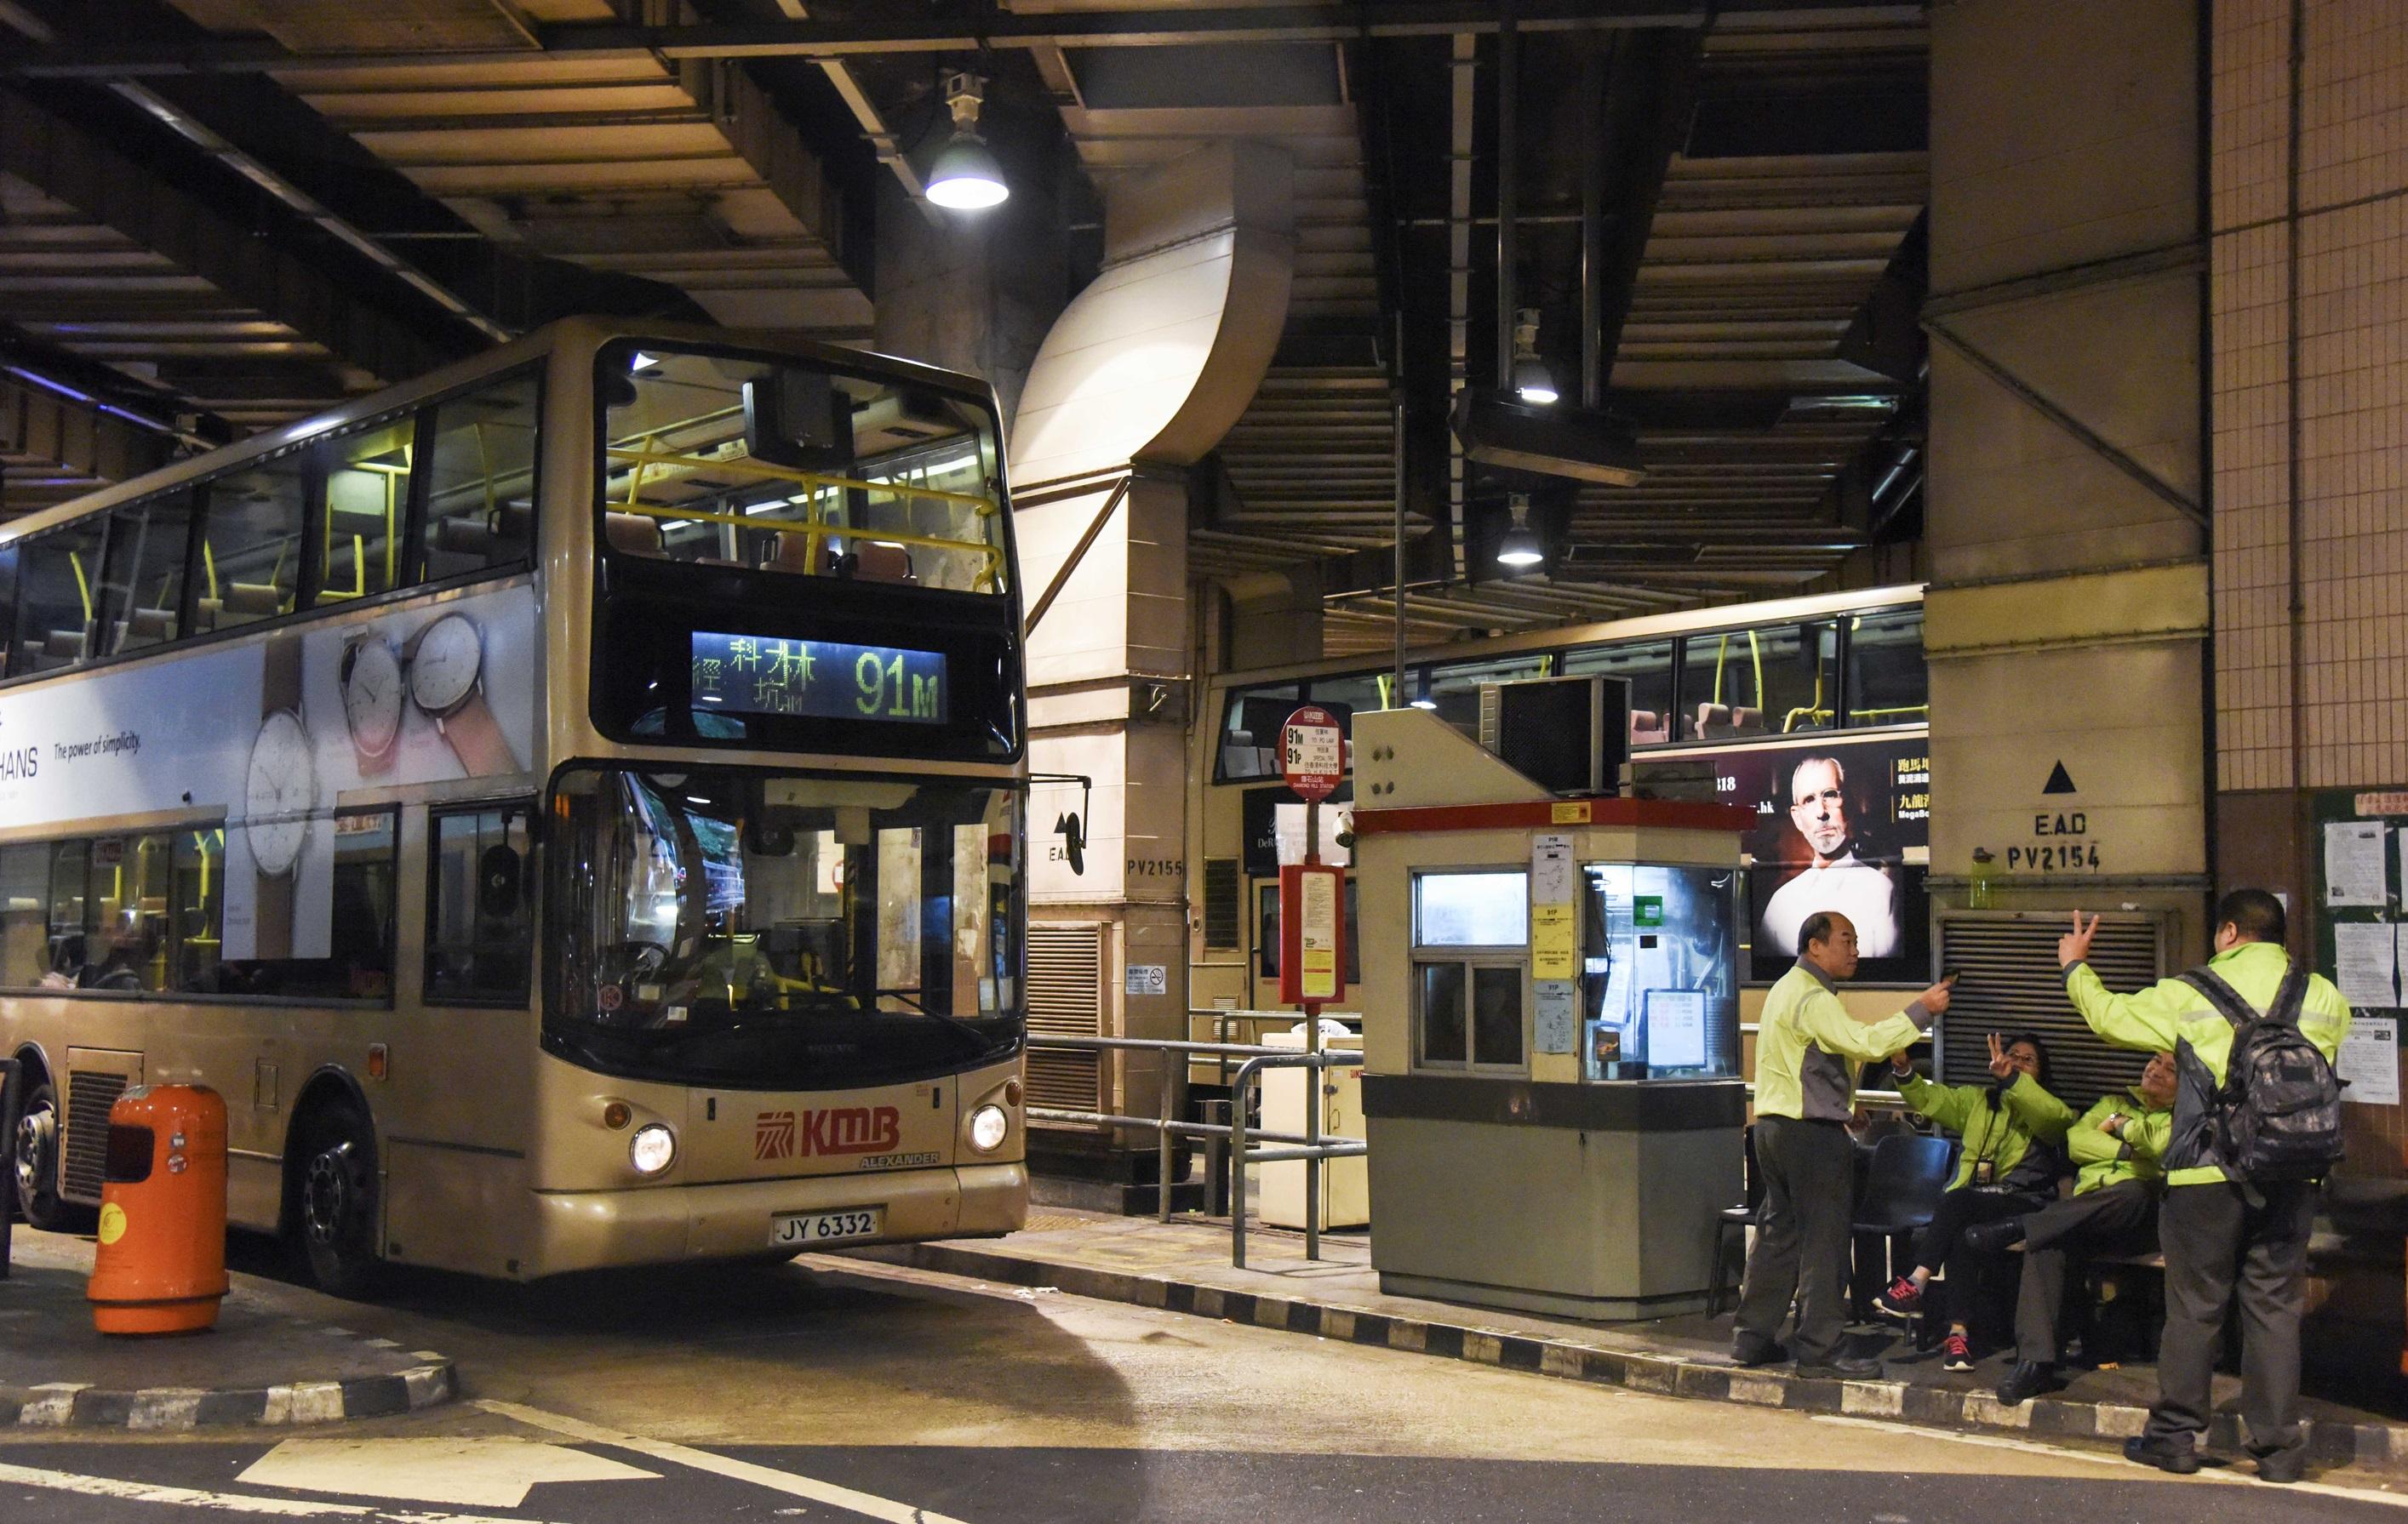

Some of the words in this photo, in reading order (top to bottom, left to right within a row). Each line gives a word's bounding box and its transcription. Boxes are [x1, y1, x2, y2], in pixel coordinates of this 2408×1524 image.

[855, 652, 938, 718] 91M
[54, 743, 66, 761] The
[68, 743, 92, 763] power
[94, 735, 102, 754] of
[102, 730, 141, 756] simplicity.
[1288, 728, 1303, 745] 91M
[1288, 747, 1301, 764] 91P
[1127, 859, 1183, 876] PV2155
[2008, 846, 2100, 870] PV2154
[801, 1106, 900, 1157] KMB
[860, 1152, 939, 1169] ALEXANDER
[781, 1219, 809, 1241] JY
[817, 1213, 872, 1237] 6332
